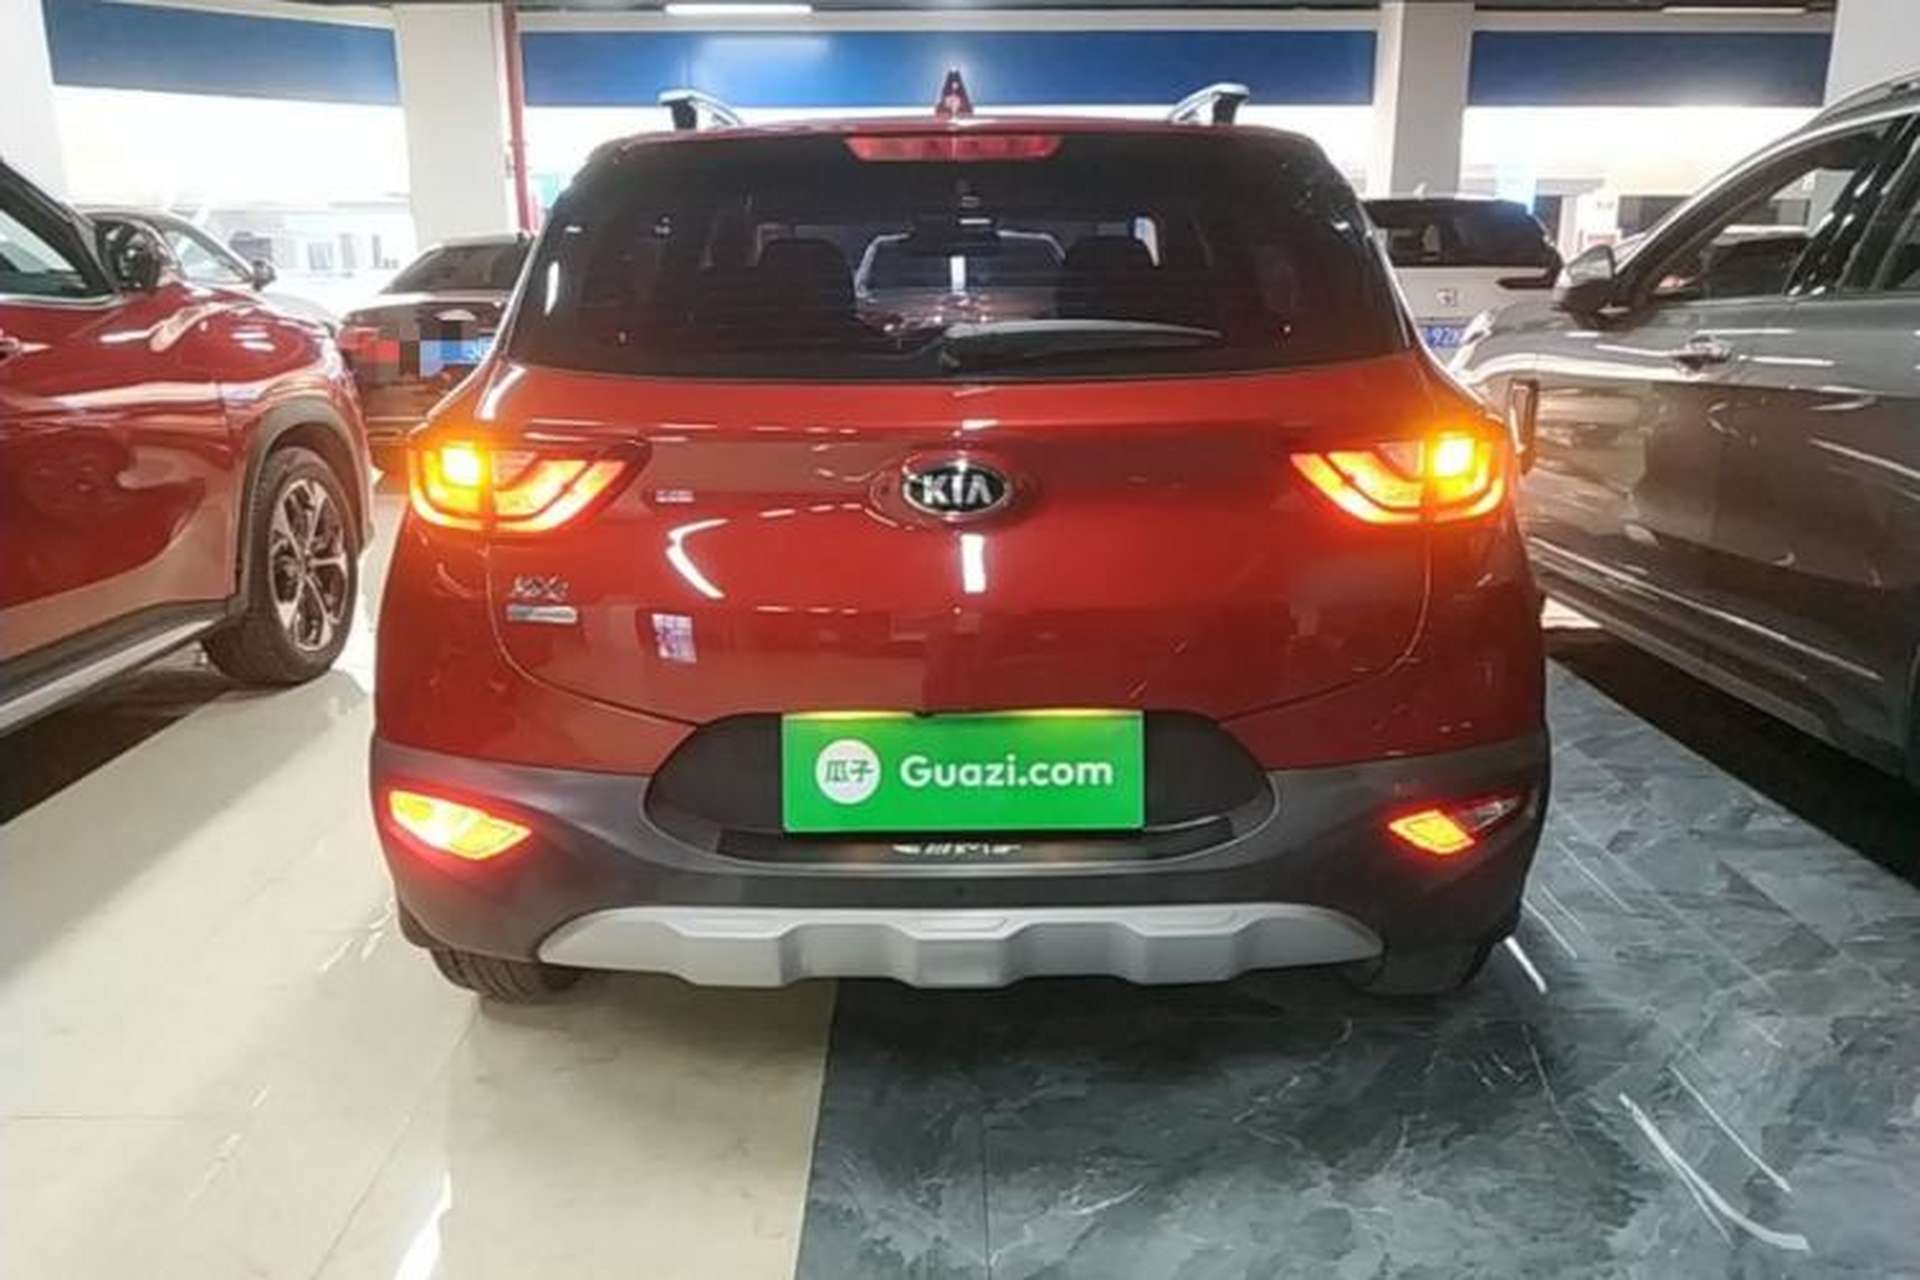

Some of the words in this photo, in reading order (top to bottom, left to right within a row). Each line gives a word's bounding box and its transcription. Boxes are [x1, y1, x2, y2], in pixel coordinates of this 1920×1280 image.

[923, 474, 992, 505] KIA
[824, 759, 875, 783] 瓜子
[900, 754, 1113, 788] Guazi.com
